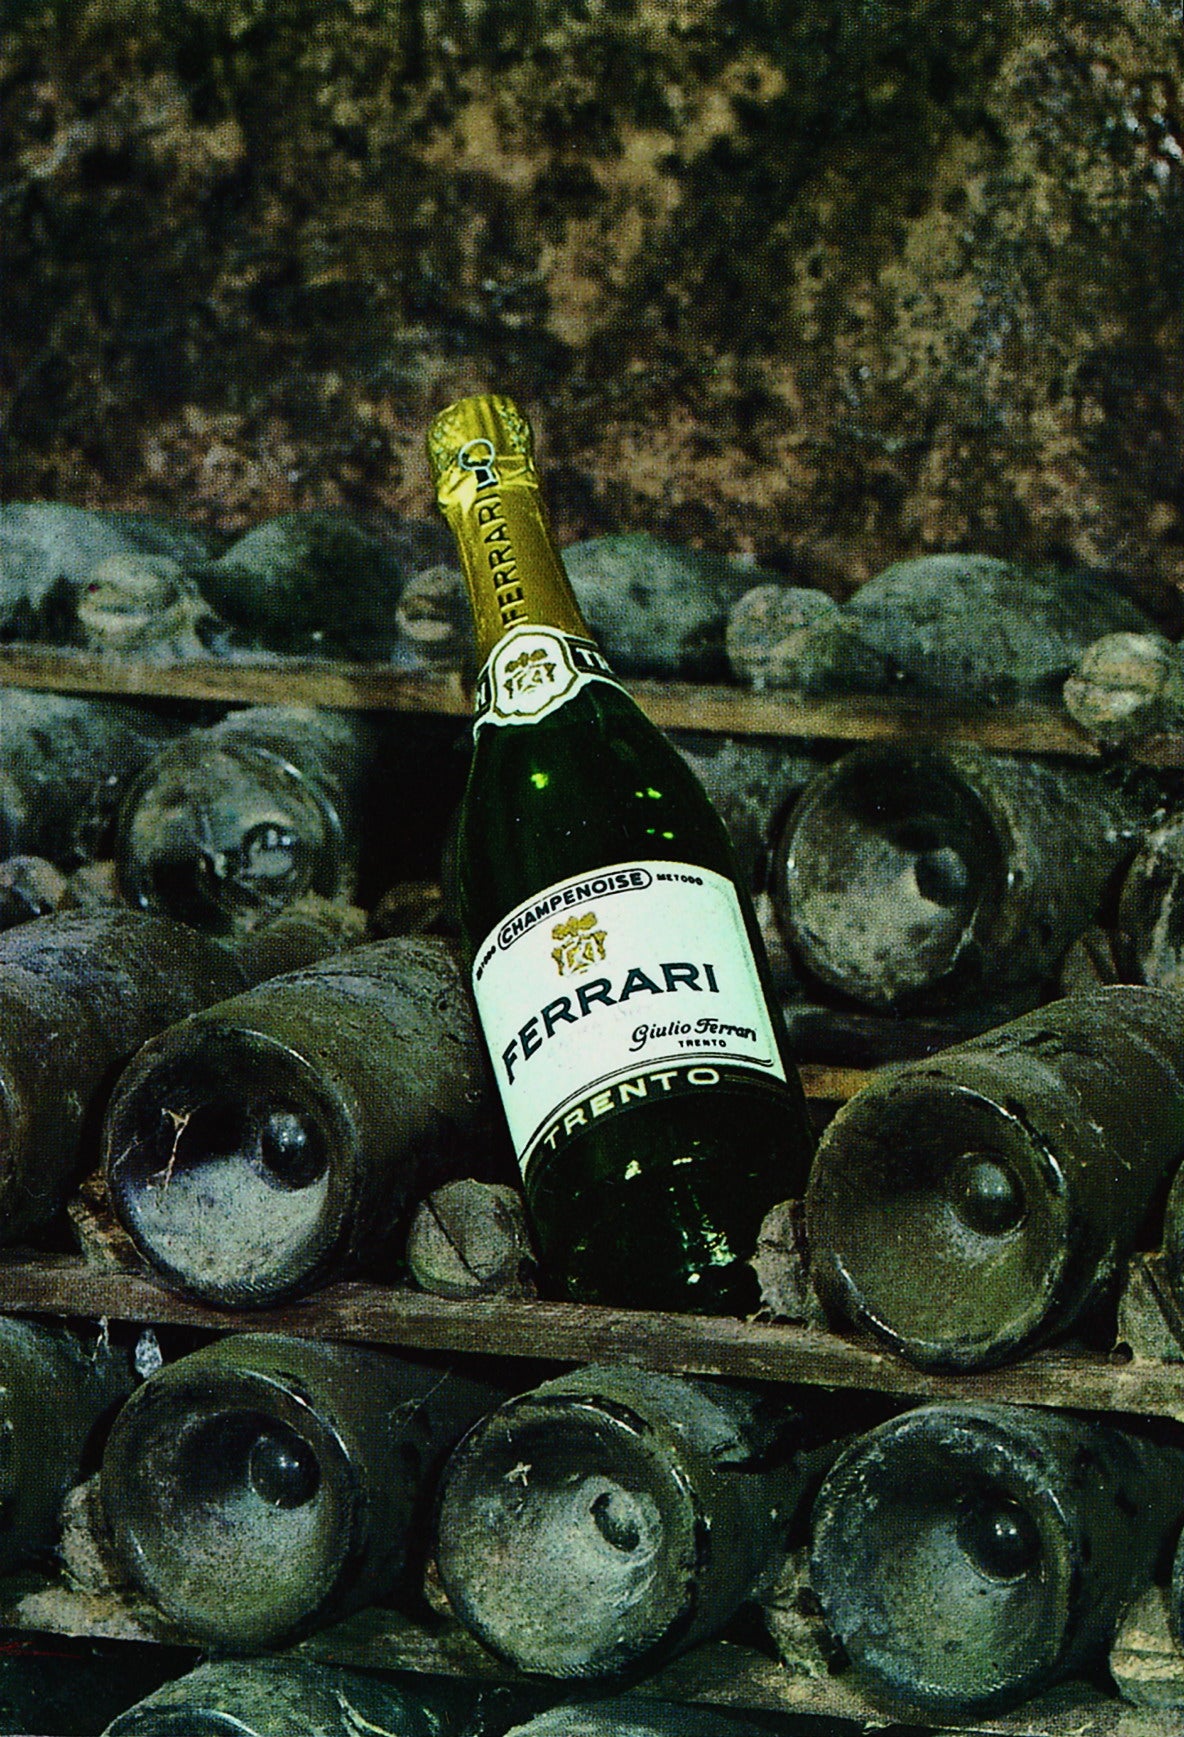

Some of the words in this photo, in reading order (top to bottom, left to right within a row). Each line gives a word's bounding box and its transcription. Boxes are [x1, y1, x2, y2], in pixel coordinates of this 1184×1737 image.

[475, 493, 529, 626] FERRARI
[502, 872, 645, 944] CHAMPENOISE
[501, 962, 720, 1086] FERRARI
[629, 1021, 692, 1052] Giulio
[678, 1039, 727, 1048] TRENTO
[543, 1067, 720, 1150] TRENTO
